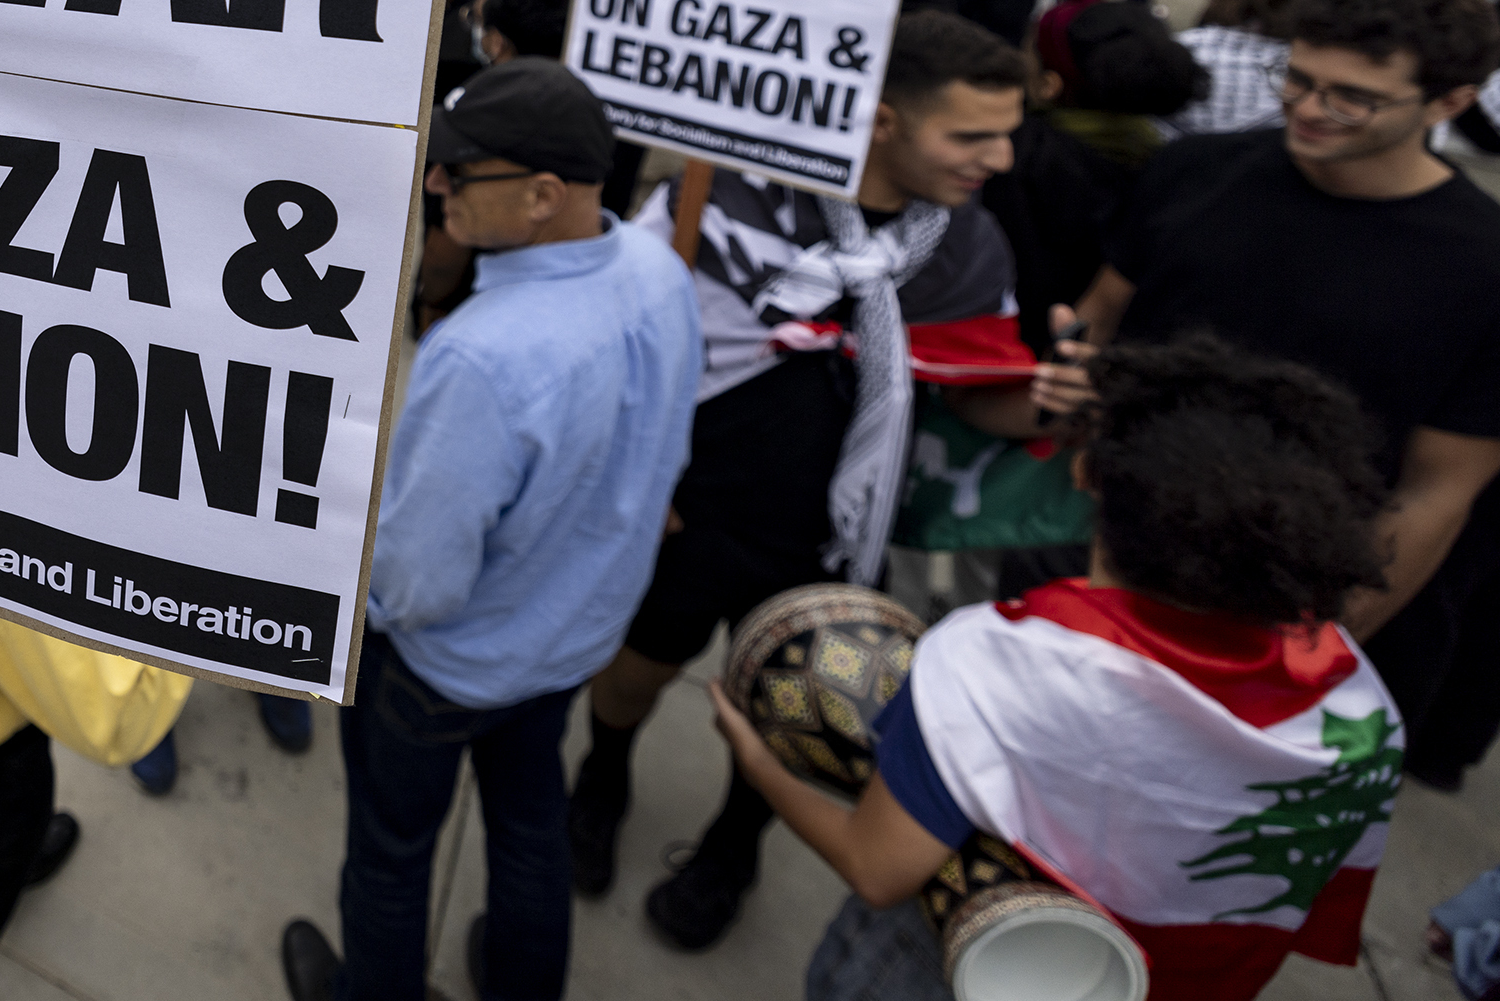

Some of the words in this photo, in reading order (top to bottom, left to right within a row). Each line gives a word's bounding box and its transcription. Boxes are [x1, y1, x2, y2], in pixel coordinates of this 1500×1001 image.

[581, 30, 859, 133] LEBANON!
[827, 26, 871, 74] &
[222, 180, 365, 342] &
[86, 569, 313, 652] Liberation
